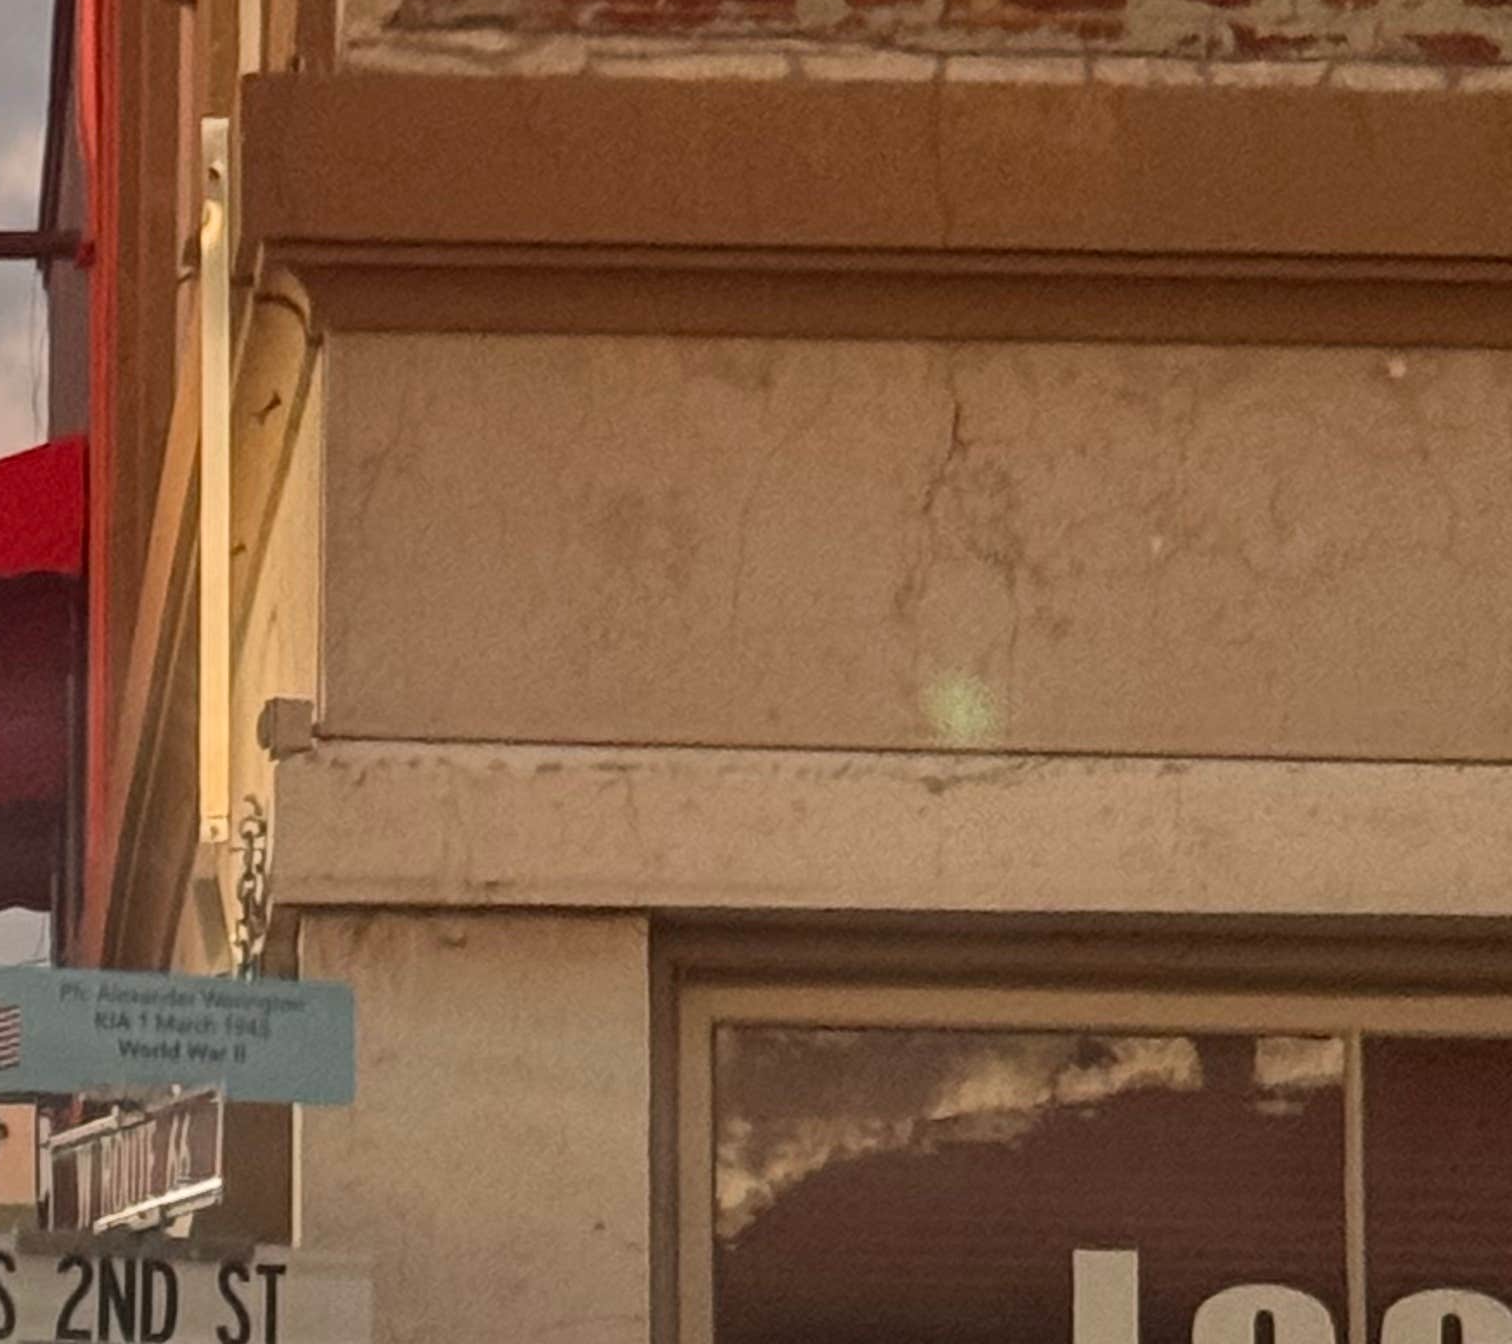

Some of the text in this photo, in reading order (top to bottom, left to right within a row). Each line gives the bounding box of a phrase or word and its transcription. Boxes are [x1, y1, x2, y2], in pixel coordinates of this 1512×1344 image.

[155, 1013, 217, 1035] March
[117, 1038, 181, 1060] World
[187, 1042, 228, 1061] War
[55, 1255, 178, 1343] 2ND
